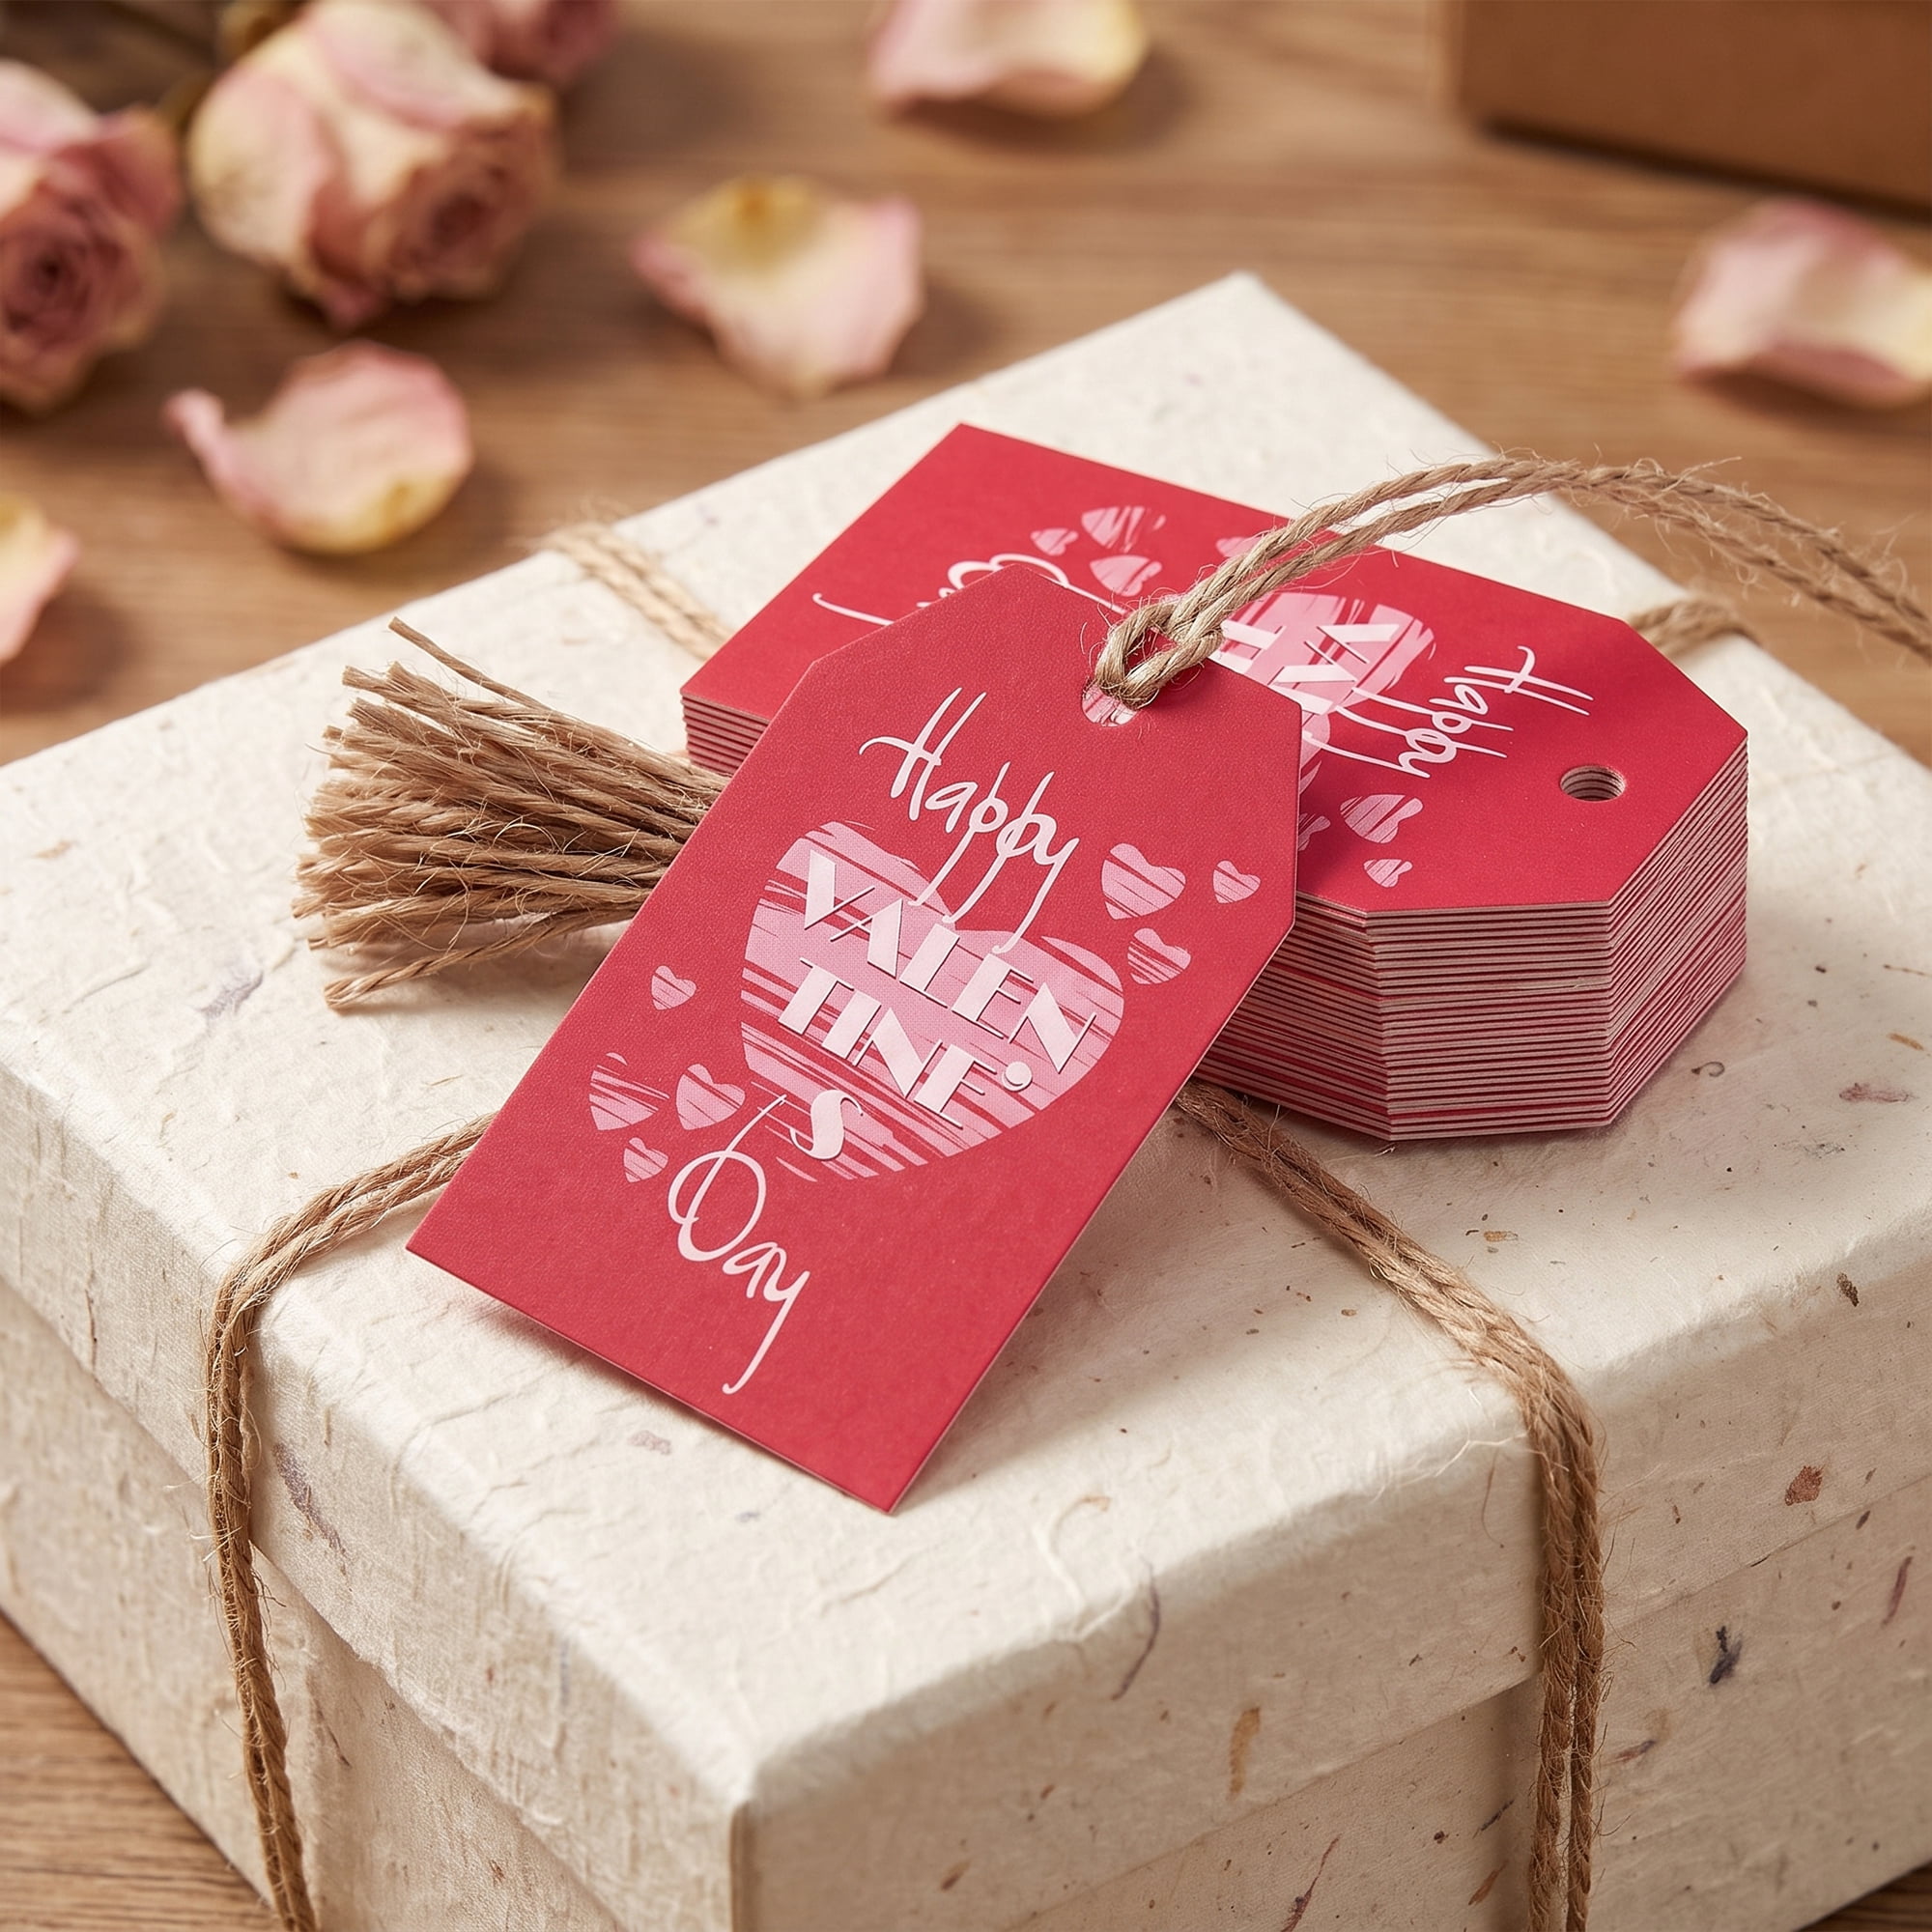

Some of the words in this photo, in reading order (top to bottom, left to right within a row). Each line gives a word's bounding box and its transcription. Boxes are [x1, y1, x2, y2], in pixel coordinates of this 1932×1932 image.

[859, 687, 1080, 953] Happy
[1302, 645, 1595, 779] Happy
[804, 848, 1097, 1074] VALEN
[668, 1094, 810, 1396] Day
